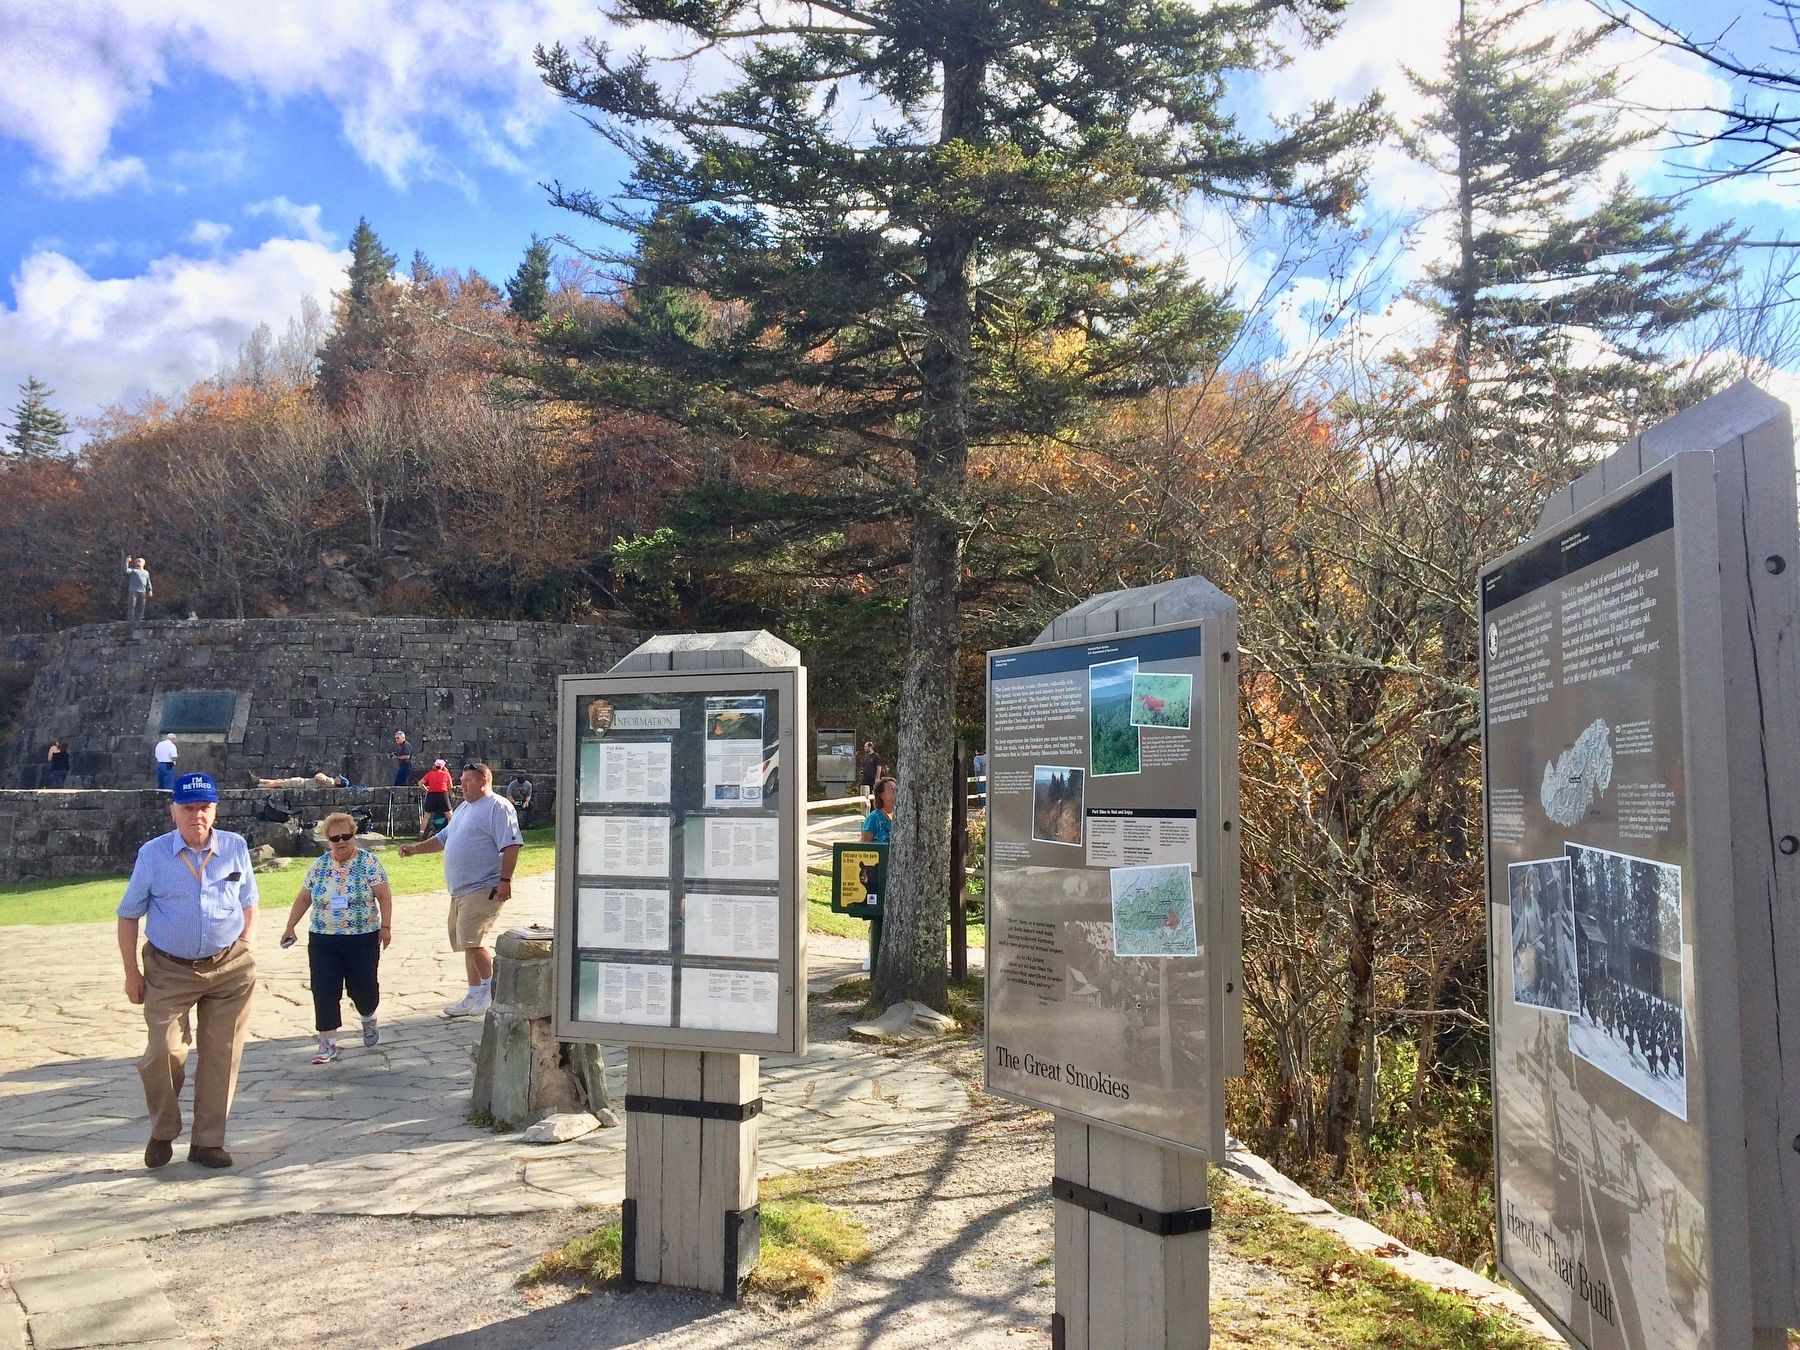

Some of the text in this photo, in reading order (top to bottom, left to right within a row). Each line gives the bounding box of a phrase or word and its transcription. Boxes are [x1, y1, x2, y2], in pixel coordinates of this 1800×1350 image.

[614, 714, 672, 726] INFORMATION
[996, 1046, 1130, 1100] The Great Smokies
[1506, 1199, 1615, 1326] Hands That Built
